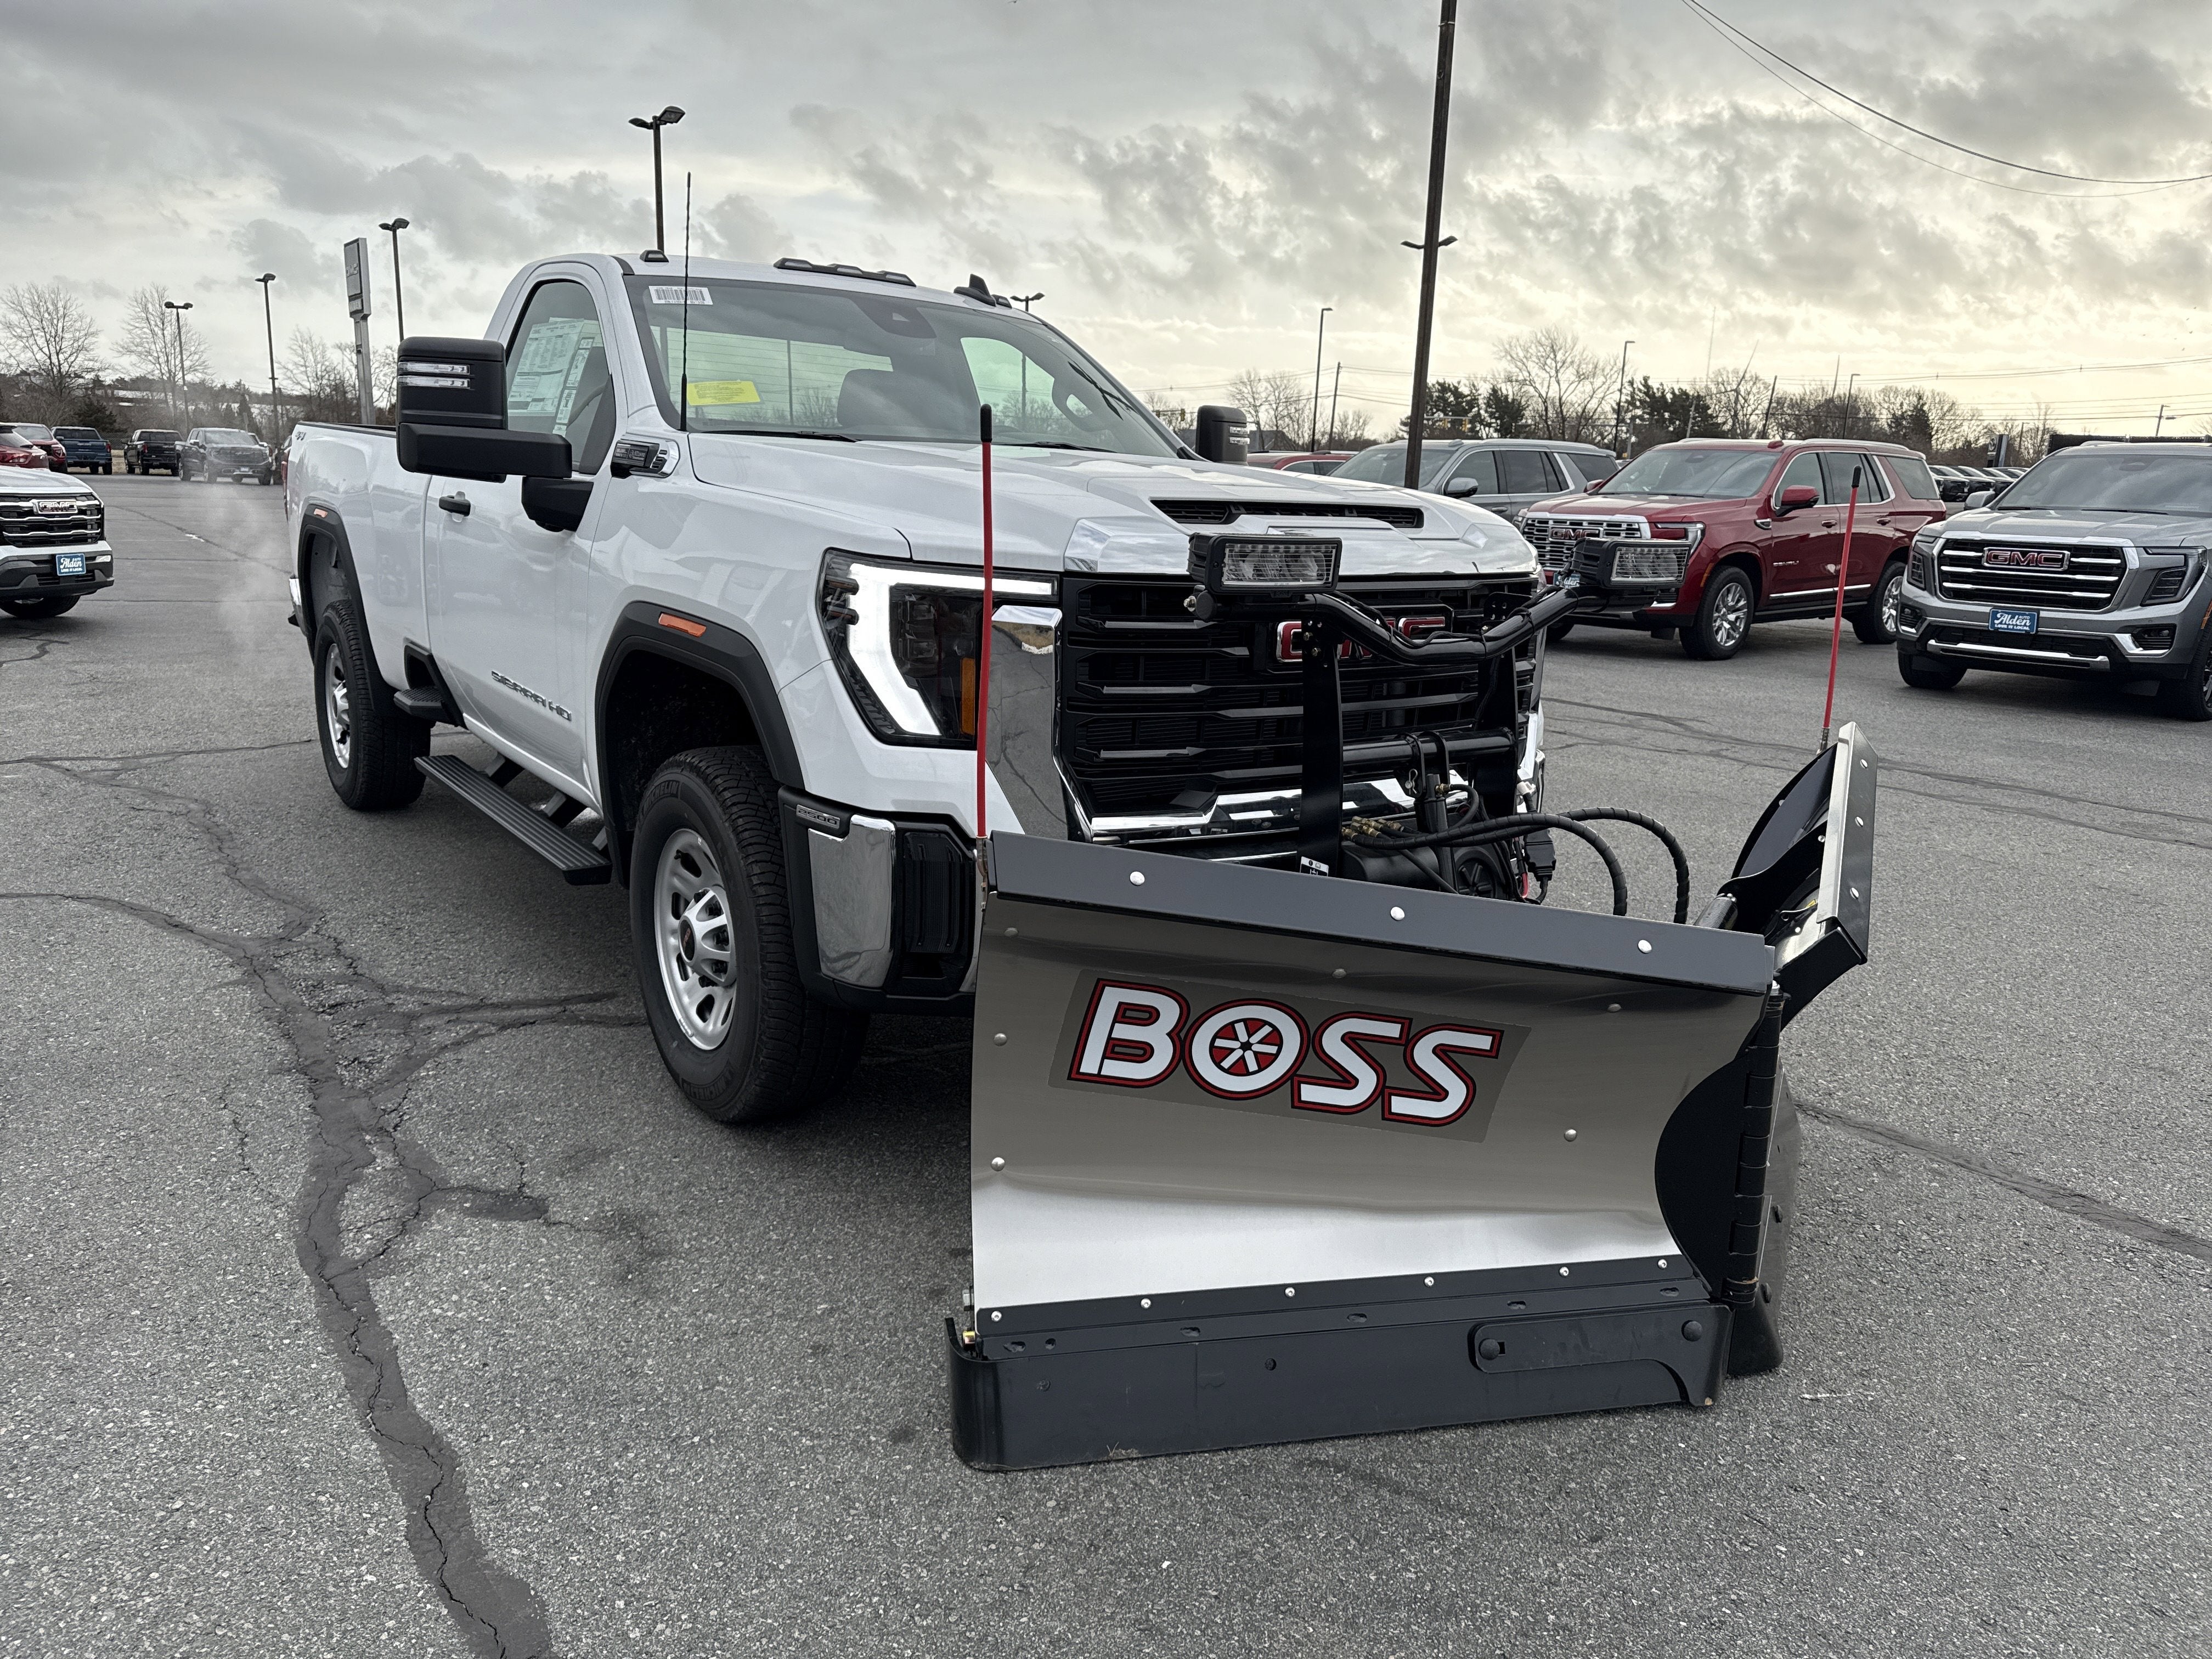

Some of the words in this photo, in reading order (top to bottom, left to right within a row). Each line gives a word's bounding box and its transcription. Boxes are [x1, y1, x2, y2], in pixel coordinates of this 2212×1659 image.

[1551, 528, 1599, 540] GMC
[60, 557, 82, 568] Alden
[1988, 550, 2063, 567] GMC
[1994, 613, 2031, 625] Alden
[492, 670, 546, 707] SIERRA
[548, 699, 572, 721] HD
[798, 808, 837, 825] 2500
[1067, 978, 1504, 1127] BOSS
